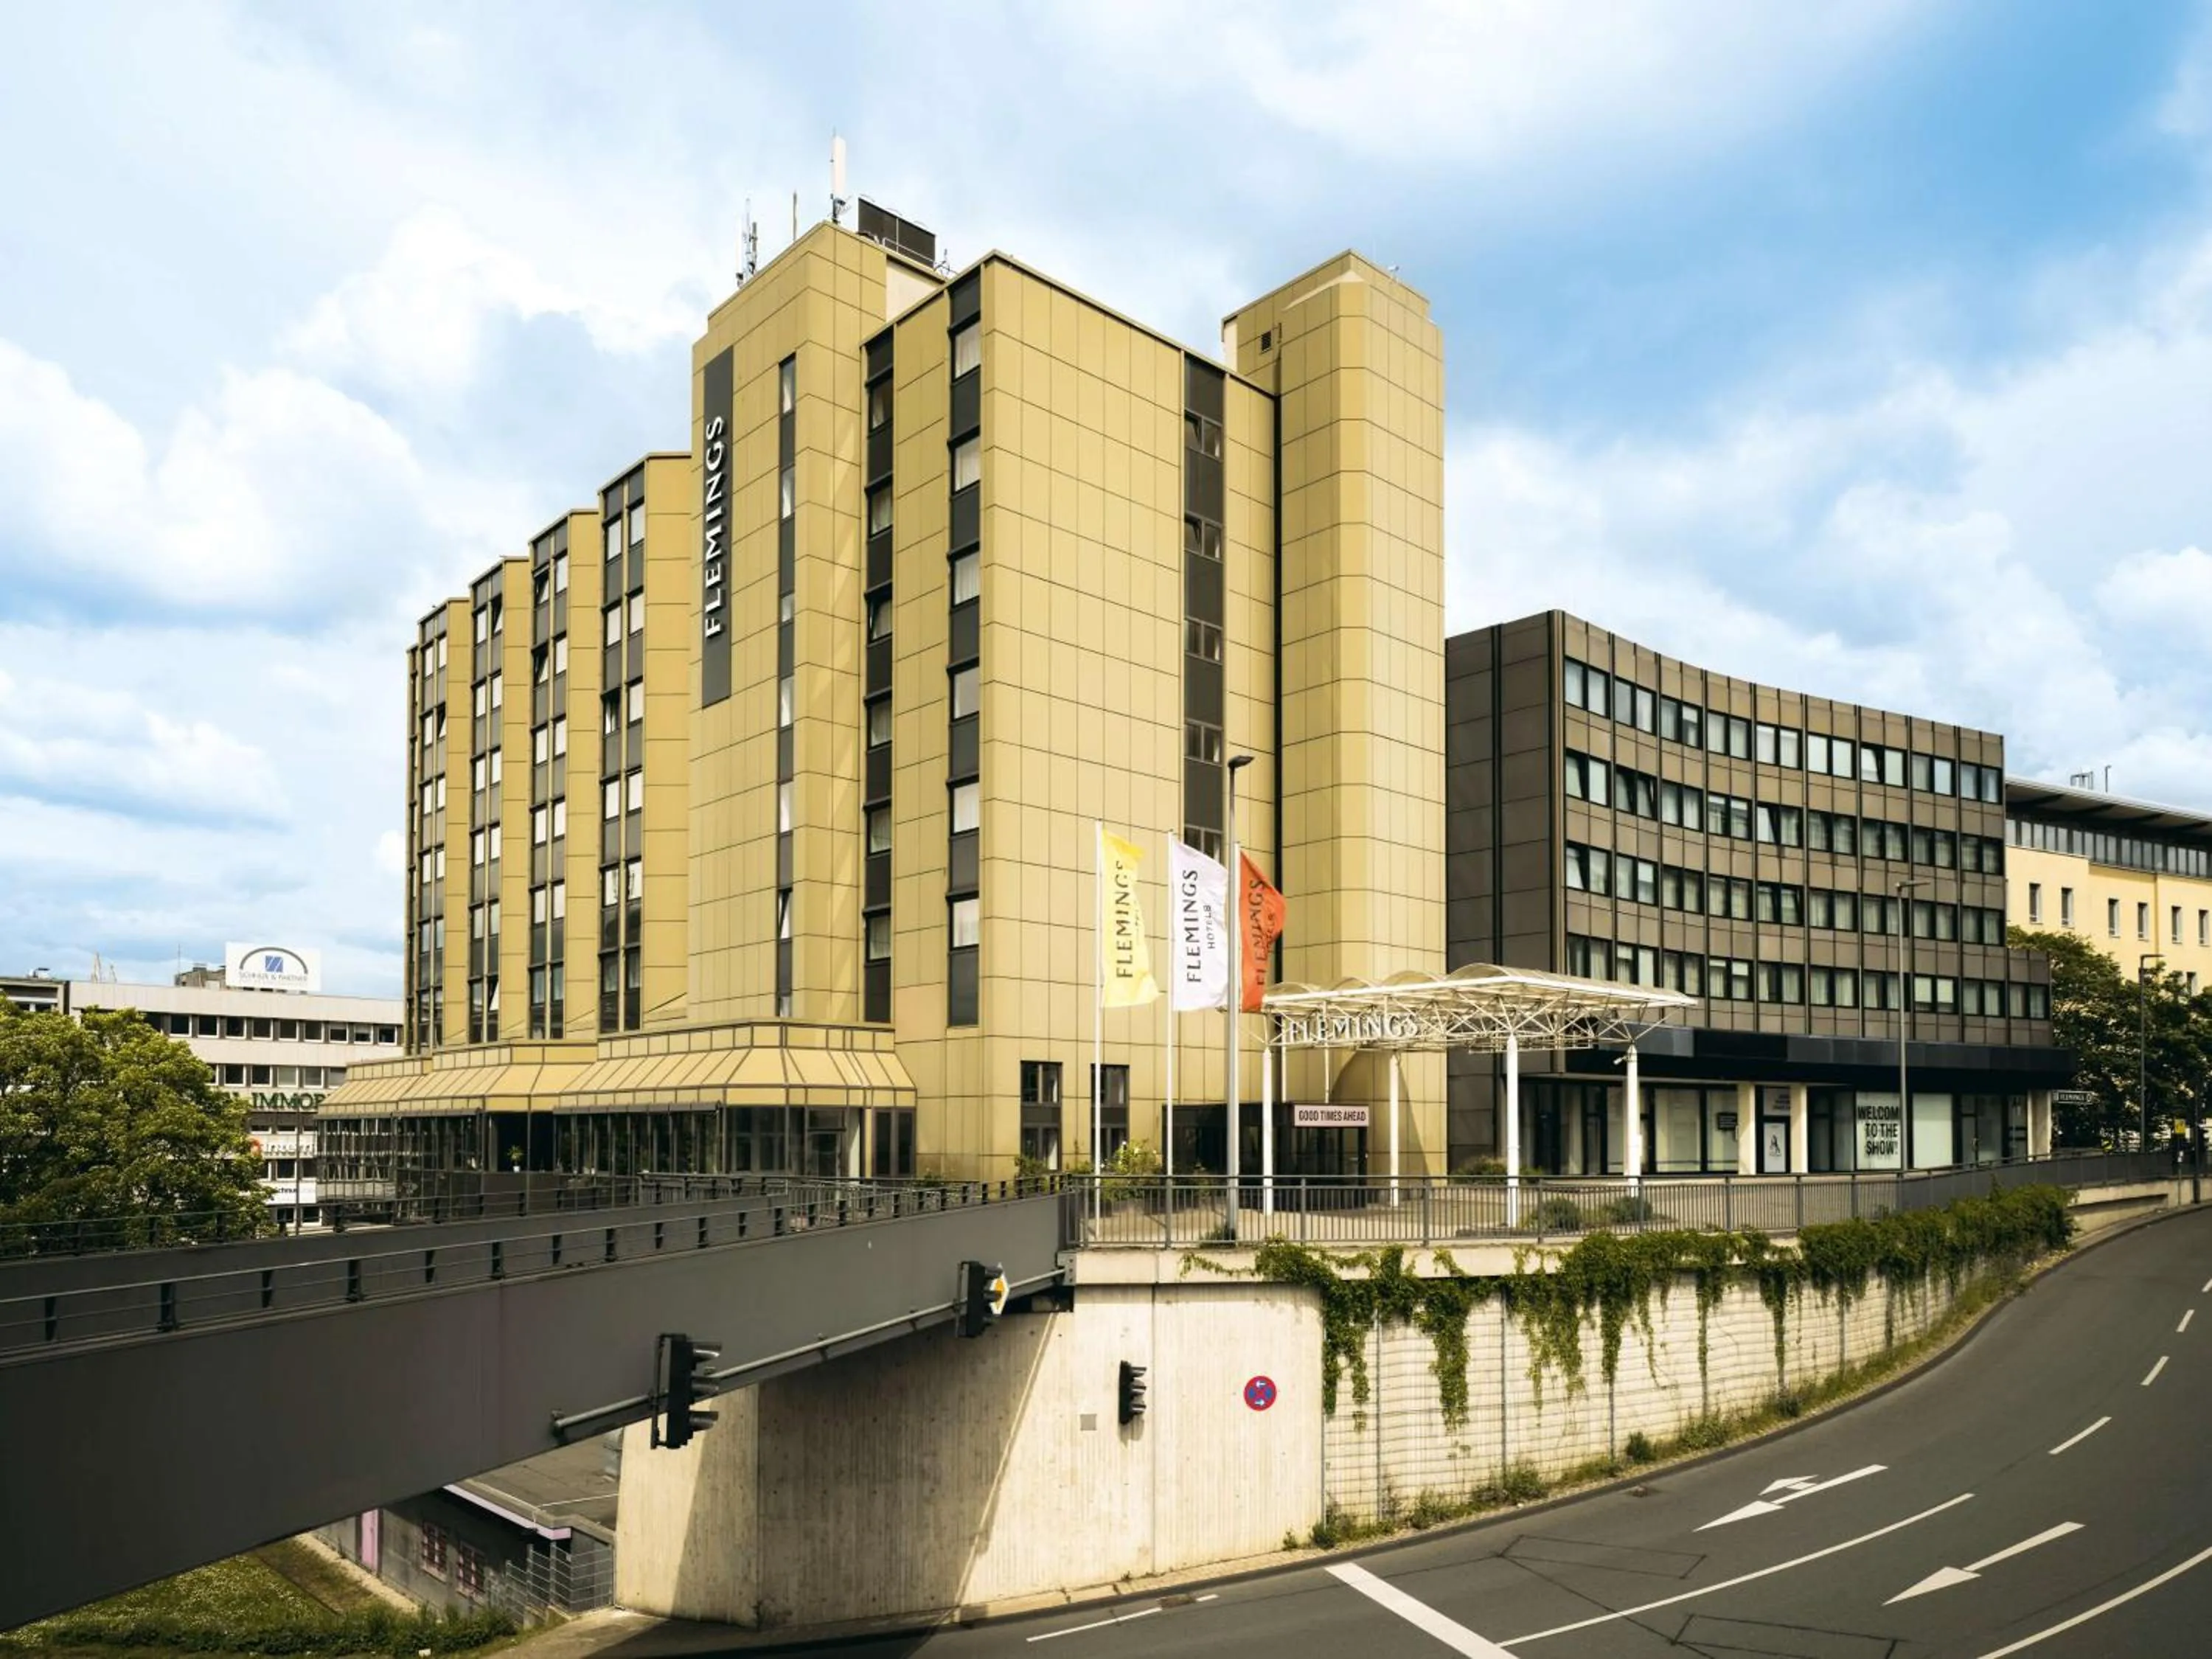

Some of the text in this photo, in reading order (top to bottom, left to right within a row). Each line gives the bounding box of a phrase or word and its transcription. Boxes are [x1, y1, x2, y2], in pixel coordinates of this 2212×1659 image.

[705, 415, 724, 639] FLEMINGS
[1182, 869, 1202, 983] FLEMINGS
[1203, 904, 1216, 950] HOTELS
[1290, 1014, 1419, 1043] FLEMINGS
[251, 1091, 331, 1109] IMMO
[1298, 1110, 1366, 1121] GOOD TIMES AHEAD
[1865, 1123, 1899, 1138] TO THE
